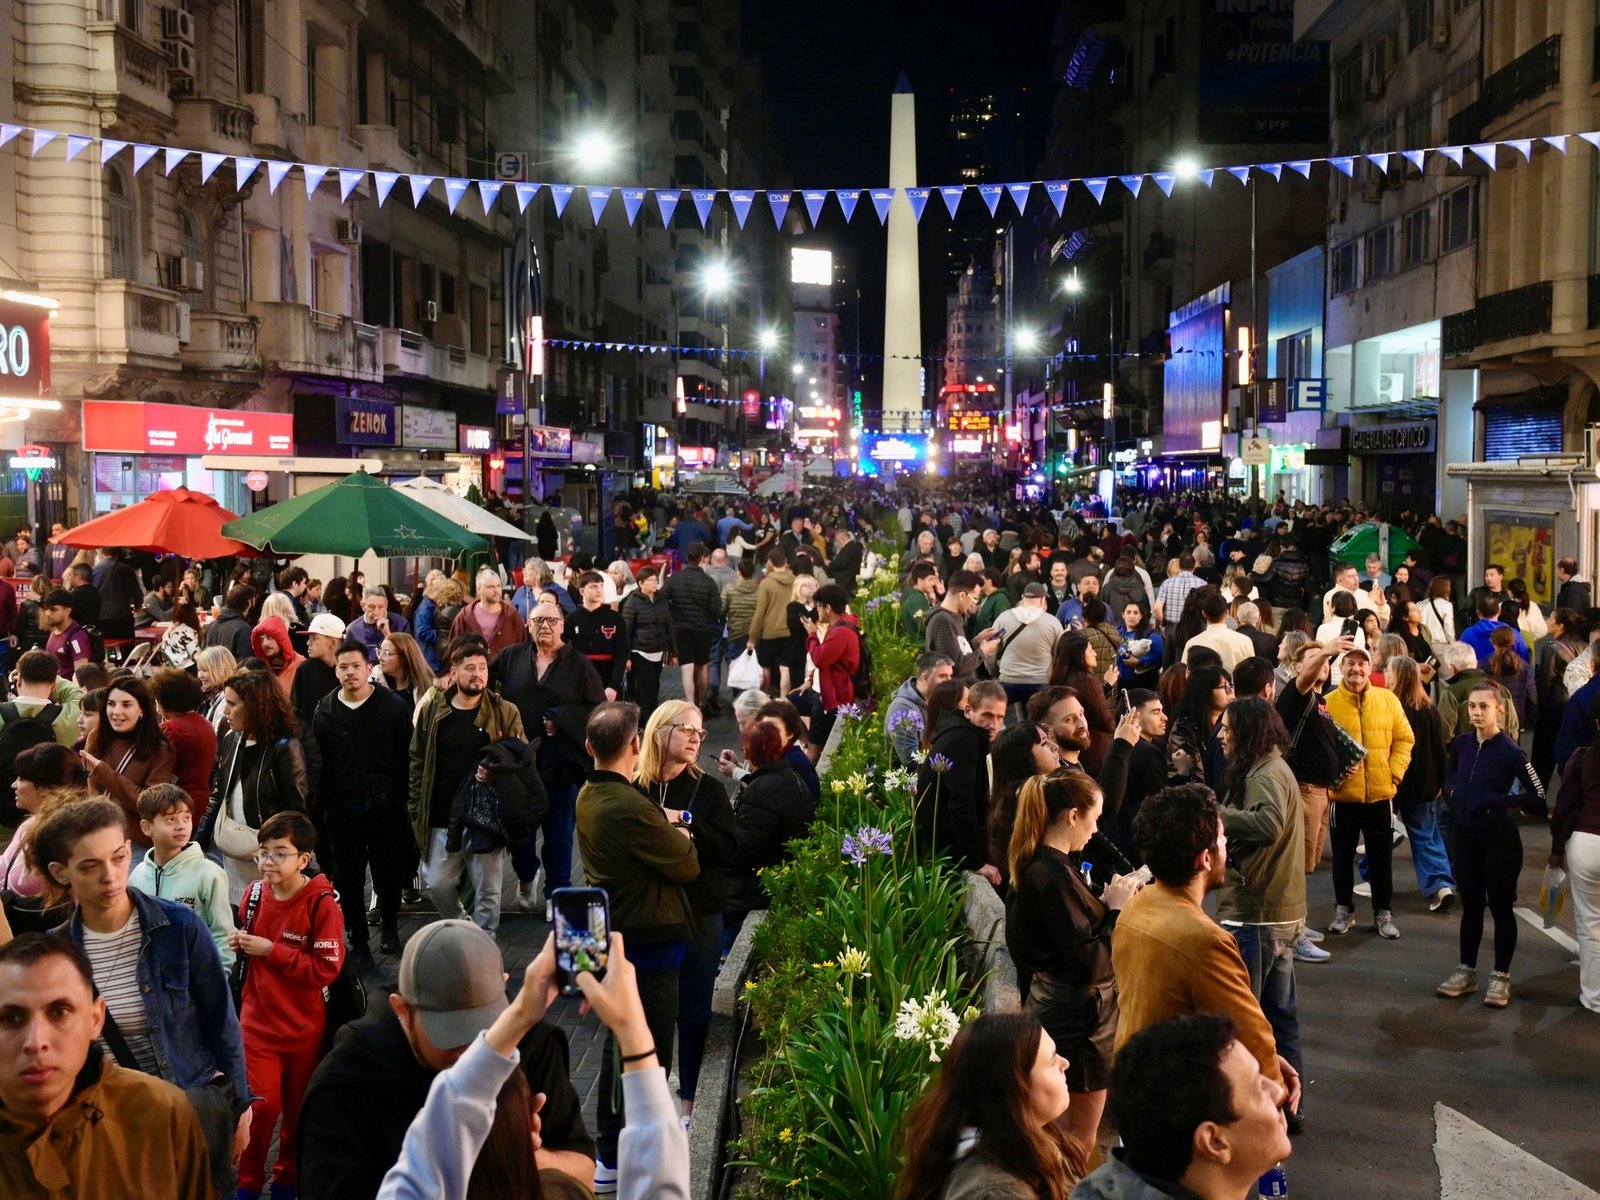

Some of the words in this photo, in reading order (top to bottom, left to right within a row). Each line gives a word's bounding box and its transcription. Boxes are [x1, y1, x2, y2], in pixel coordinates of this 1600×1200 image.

[1257, 120, 1290, 131] YPF
[502, 157, 516, 175] E
[1298, 381, 1321, 408] E
[352, 412, 387, 435] ZENOK
[1352, 430, 1380, 449] GALERIA
[1382, 430, 1394, 448] DEL
[283, 931, 308, 941] WORLD
